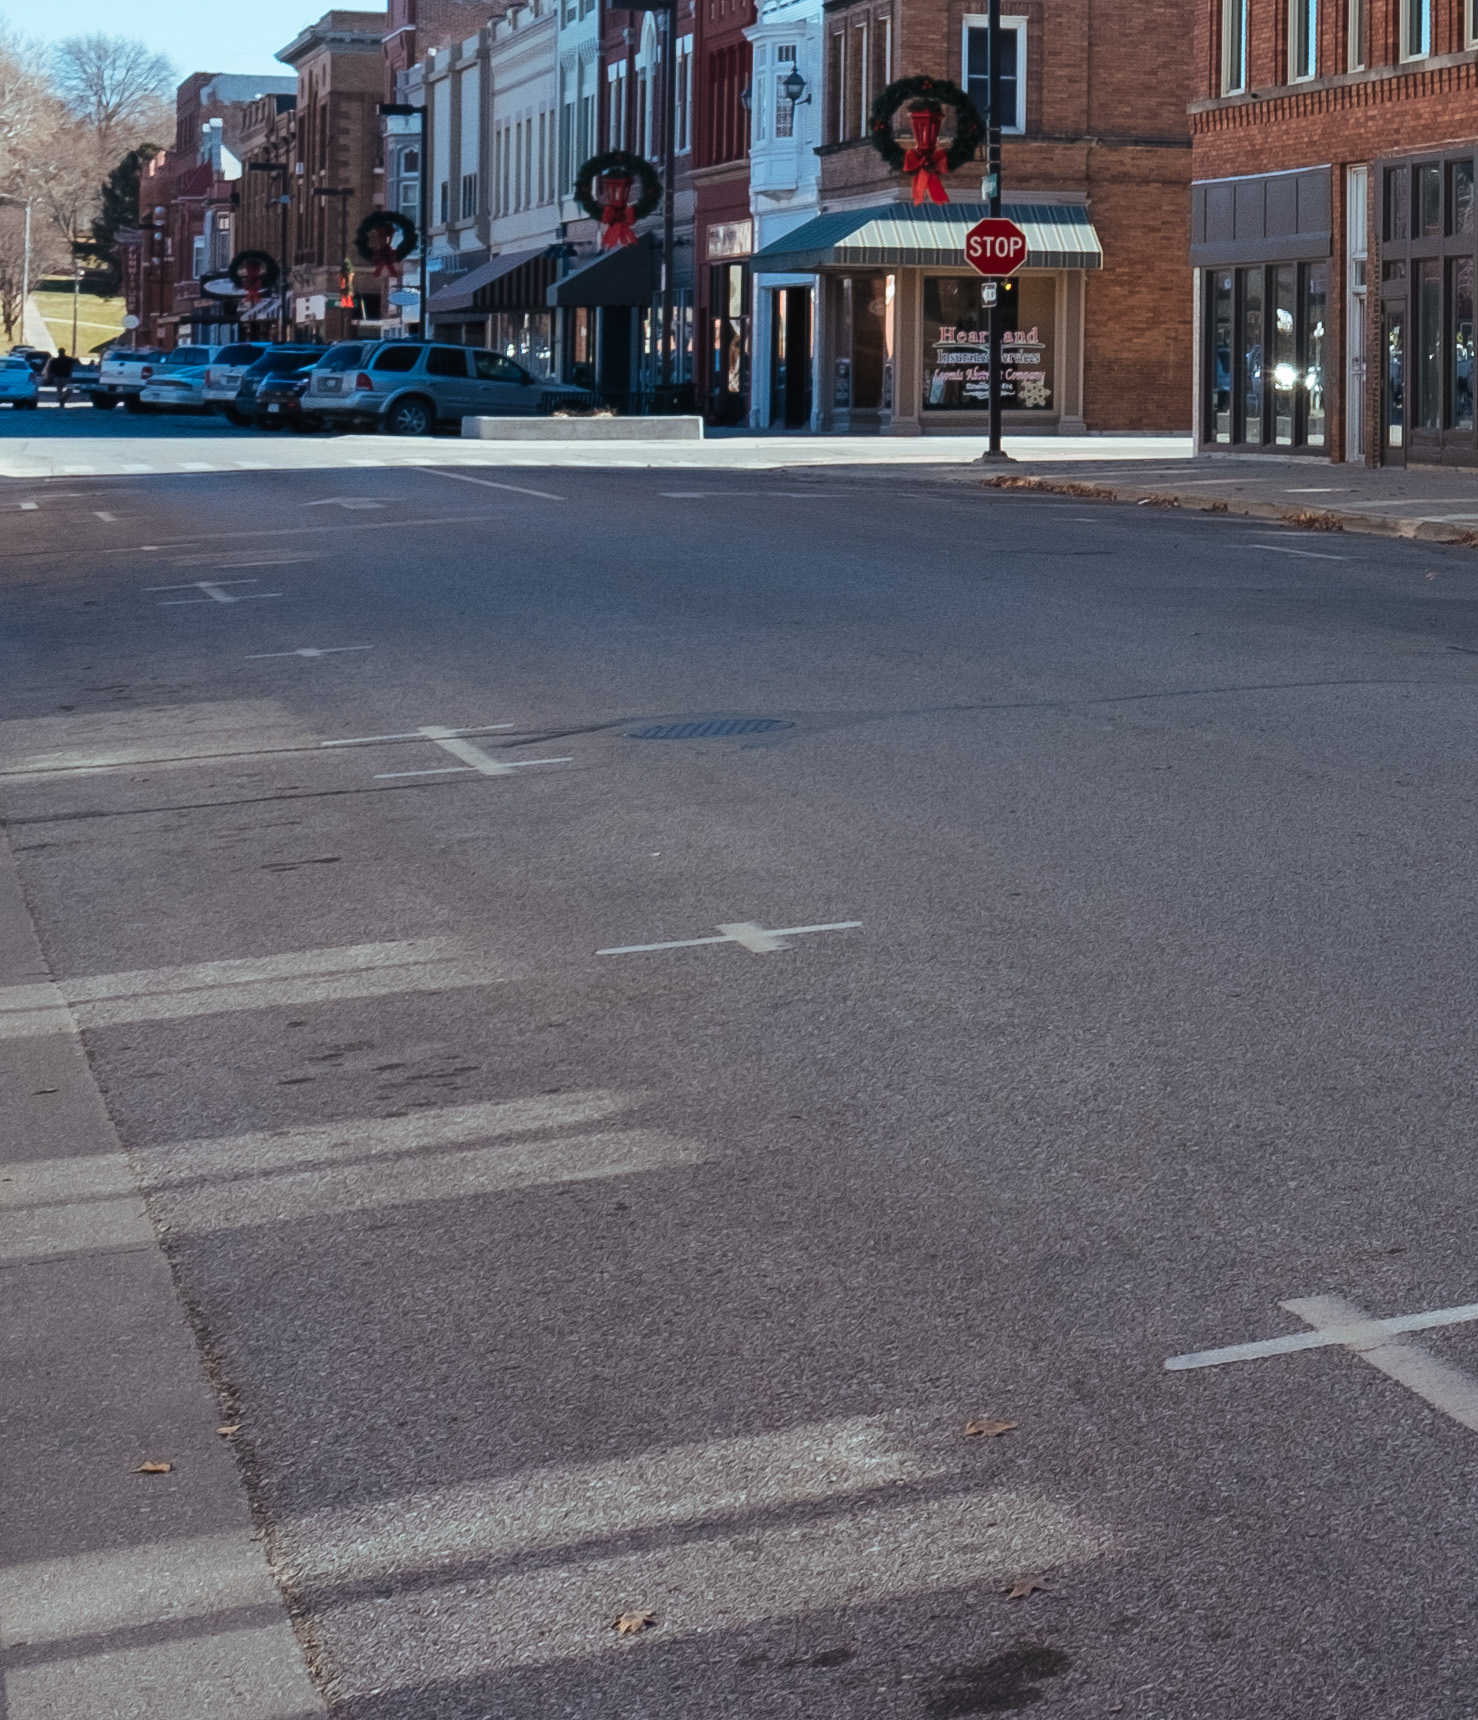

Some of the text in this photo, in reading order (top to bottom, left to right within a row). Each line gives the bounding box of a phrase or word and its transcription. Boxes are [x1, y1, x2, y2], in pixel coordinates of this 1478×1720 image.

[969, 236, 1023, 258] STOP
[939, 326, 1039, 343] Hearand
[1001, 349, 1041, 364] ervices
